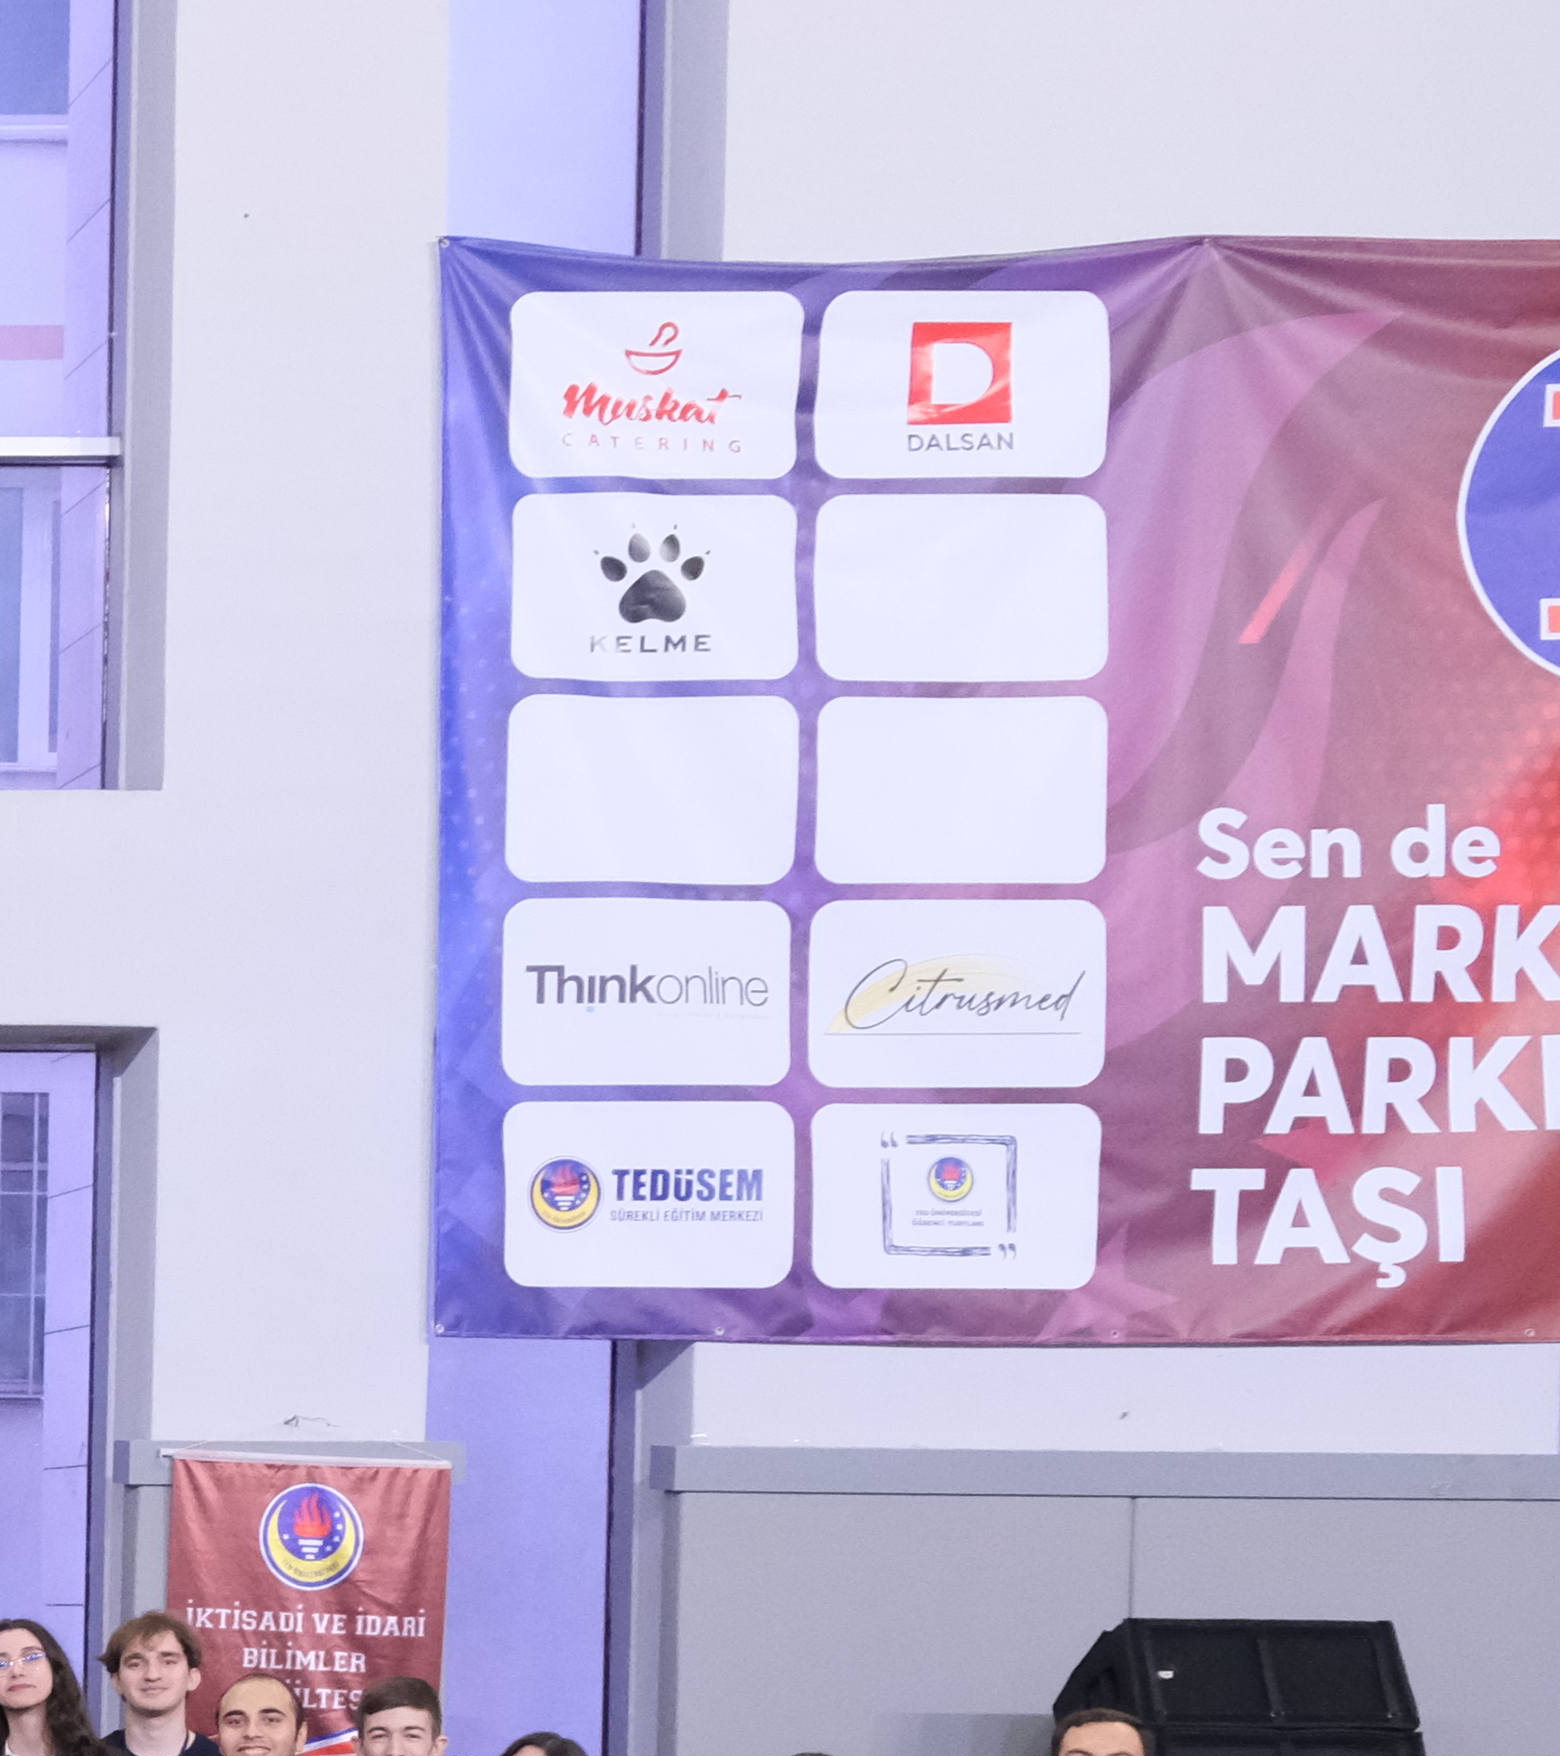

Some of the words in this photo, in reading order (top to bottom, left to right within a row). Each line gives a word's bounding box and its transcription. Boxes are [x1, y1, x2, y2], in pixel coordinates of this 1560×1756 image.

[563, 381, 742, 426] Muskat
[562, 433, 741, 453] CATERING
[907, 433, 1014, 452] DALSAN
[590, 635, 711, 652] KELME
[1196, 807, 1362, 880] Sen
[1390, 803, 1501, 878] de
[525, 964, 769, 1007] Thinkonline
[844, 958, 1086, 1030] Citrusmed
[1189, 1166, 1466, 1288] TAŞI
[186, 1599, 304, 1633] İKTİSADİ
[311, 1612, 347, 1635] VE
[355, 1607, 426, 1637] İDARİ
[242, 1640, 367, 1674] BİLİMLER
